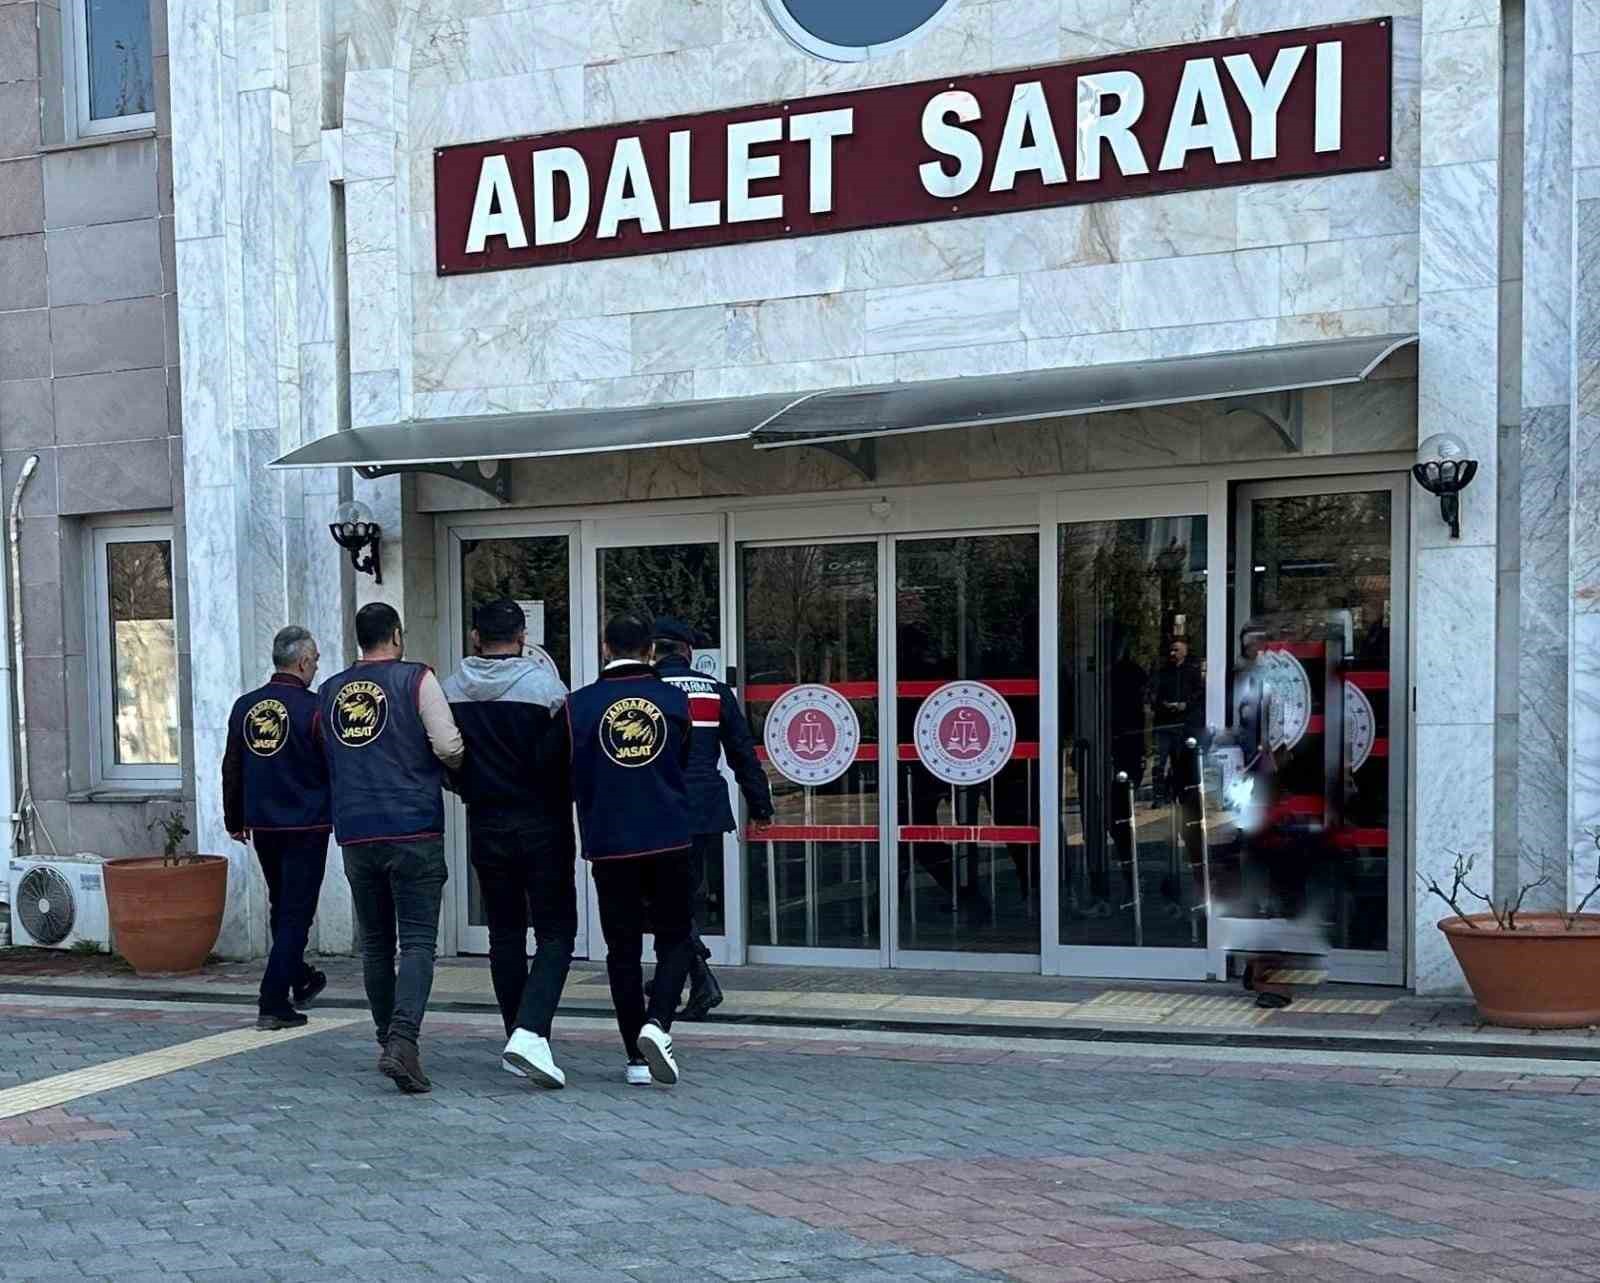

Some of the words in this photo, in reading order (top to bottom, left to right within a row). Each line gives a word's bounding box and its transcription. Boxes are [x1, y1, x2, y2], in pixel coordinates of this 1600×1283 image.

[464, 107, 854, 254] ADALET
[918, 41, 1343, 198] SARAYI
[606, 700, 661, 723] JANDARMA
[341, 726, 374, 738] JASAT
[616, 745, 652, 758] JASAT
